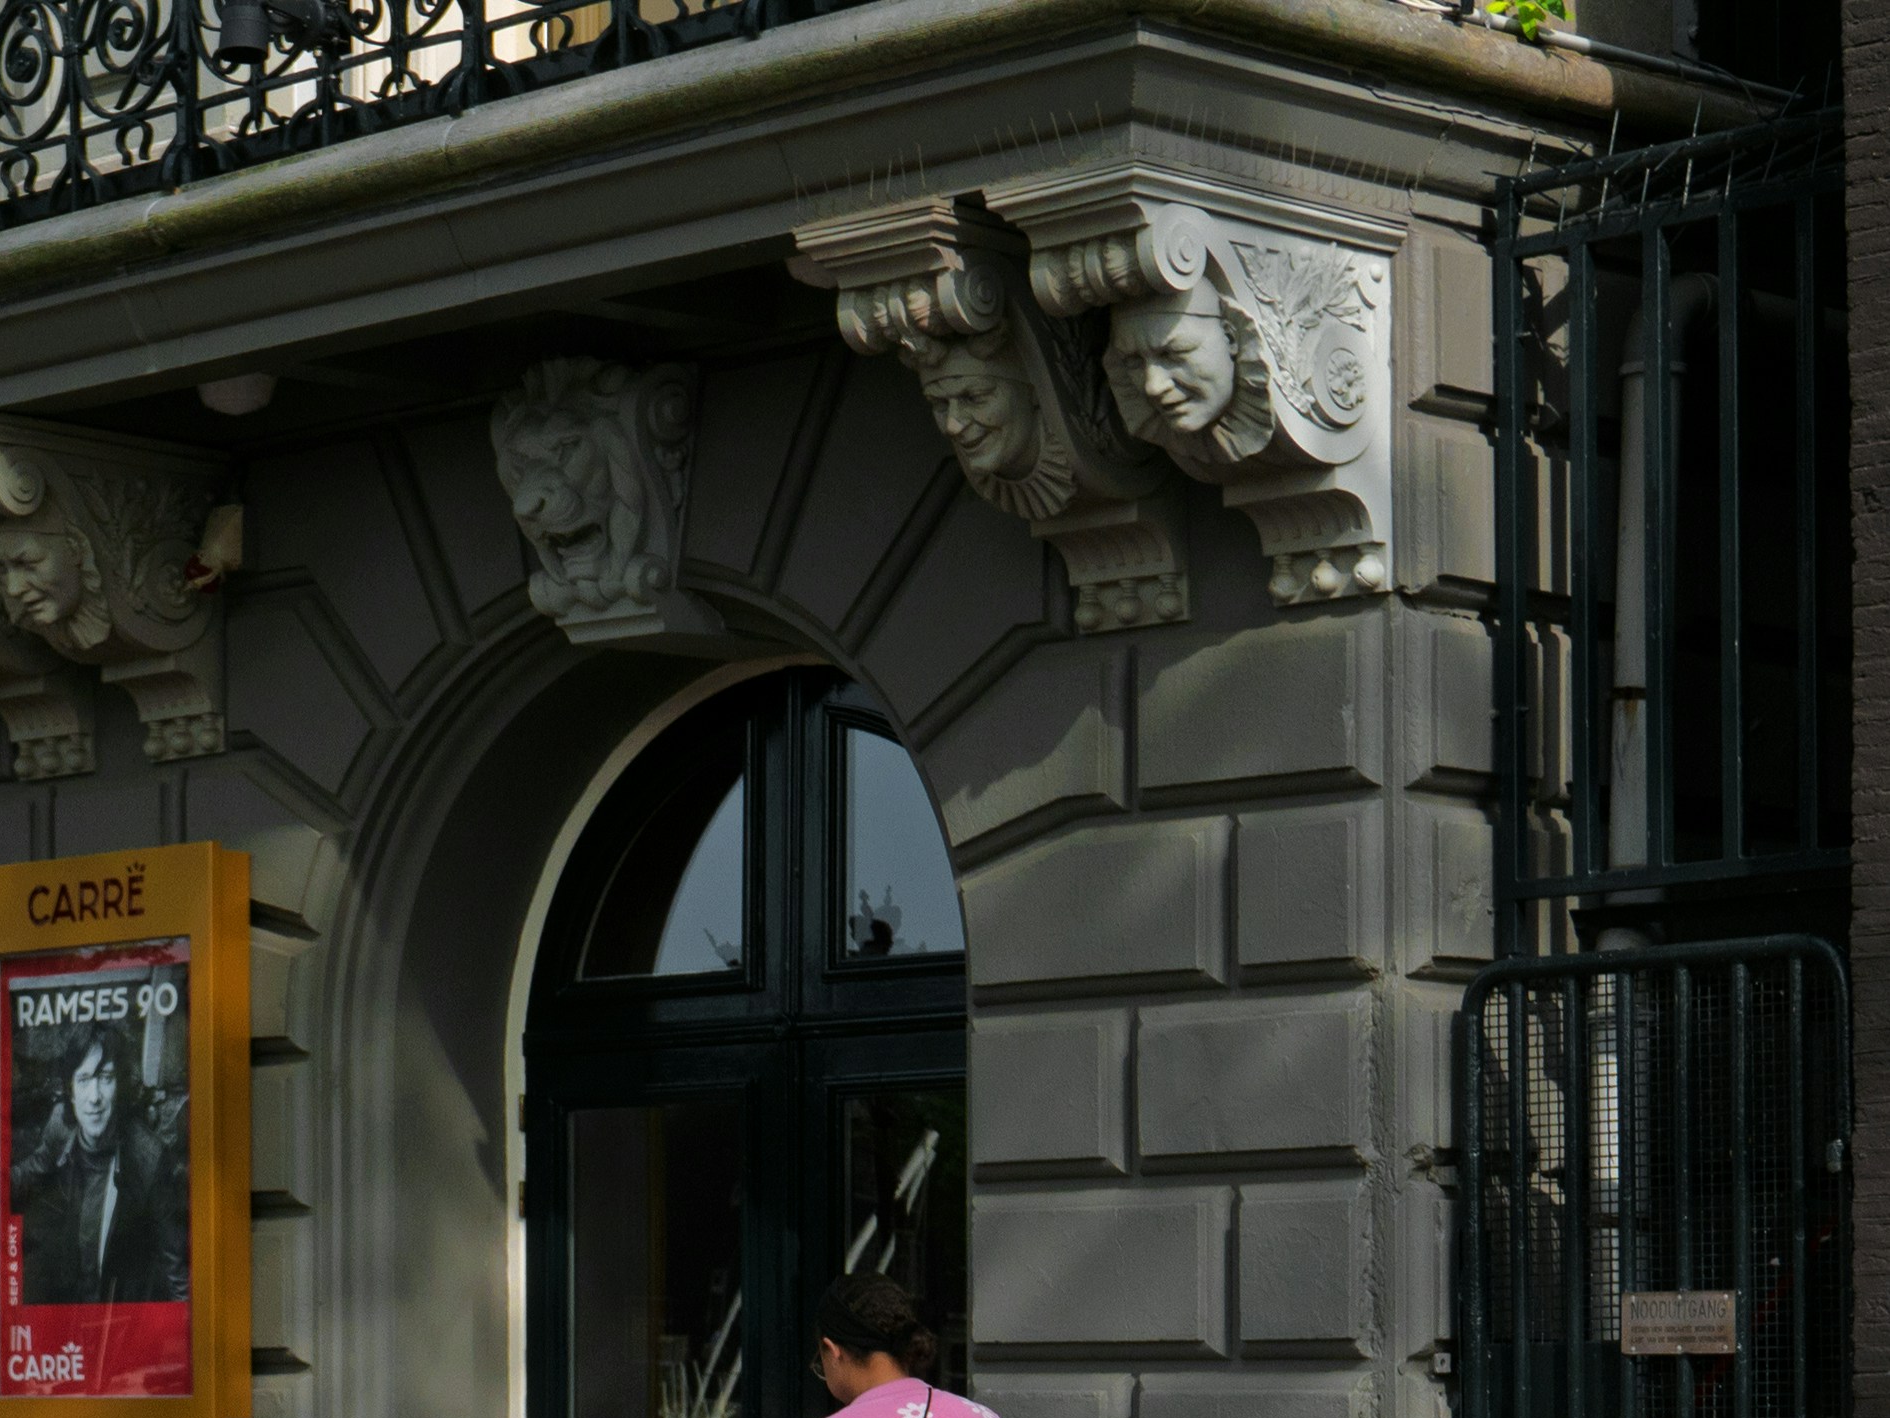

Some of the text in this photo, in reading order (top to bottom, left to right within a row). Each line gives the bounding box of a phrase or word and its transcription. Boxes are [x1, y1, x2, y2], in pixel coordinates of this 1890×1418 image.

[17, 981, 178, 1028] RAMSES 90
[8, 1223, 18, 1257] OKT
[10, 1325, 31, 1352] IN
